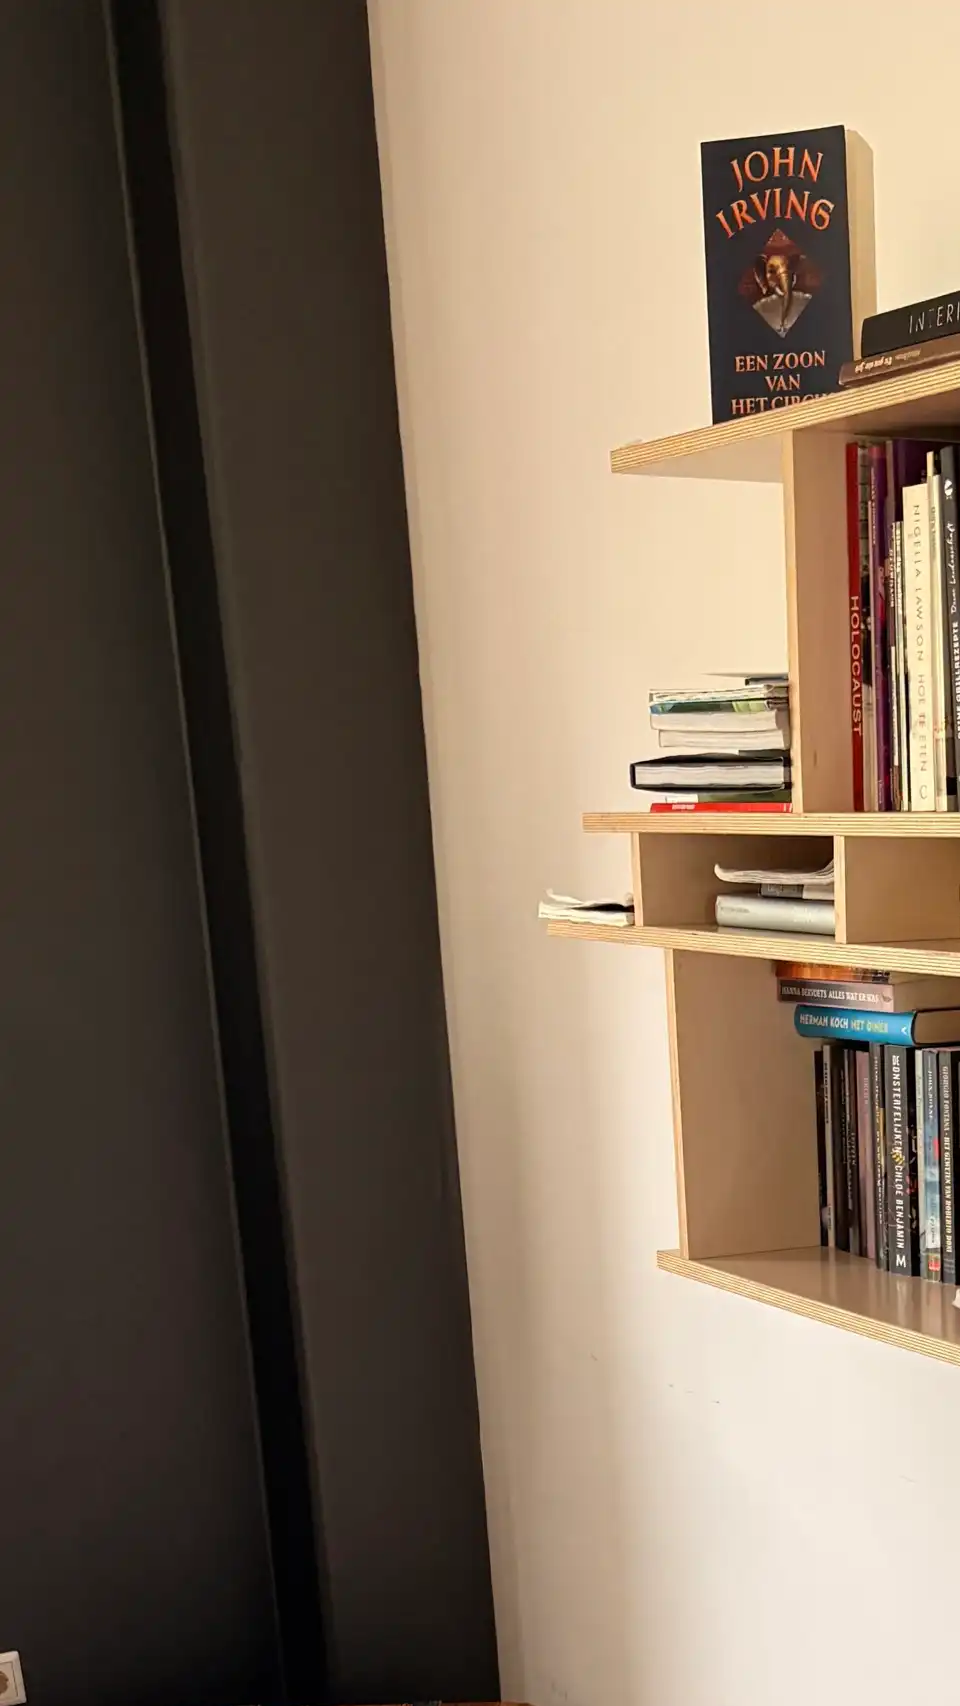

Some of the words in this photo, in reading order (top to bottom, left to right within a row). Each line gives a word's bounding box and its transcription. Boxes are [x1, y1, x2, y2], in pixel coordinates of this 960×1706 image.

[730, 147, 823, 192] JOHN
[715, 187, 835, 239] IRVING
[734, 356, 770, 373] EEN
[773, 350, 826, 371] ZOON
[765, 373, 801, 392] VAN
[731, 397, 768, 415] HET
[912, 504, 923, 579] NIGELLA
[914, 587, 924, 661] LAWSON
[850, 595, 862, 736] HOLOCAUST
[917, 674, 926, 704] HOE
[918, 711, 926, 727] TE
[918, 734, 927, 772] ETEN
[828, 989, 845, 1000] ALLES
[845, 991, 859, 1001] WAT
[799, 1013, 829, 1027] HERMAN
[829, 1016, 849, 1029] KOCH
[850, 1018, 865, 1030] HET
[892, 1054, 900, 1066] DE
[892, 1066, 903, 1155] ONSTERFELIJKEN
[895, 1164, 904, 1196] CHLOE
[895, 1199, 905, 1249] BENJAMIN
